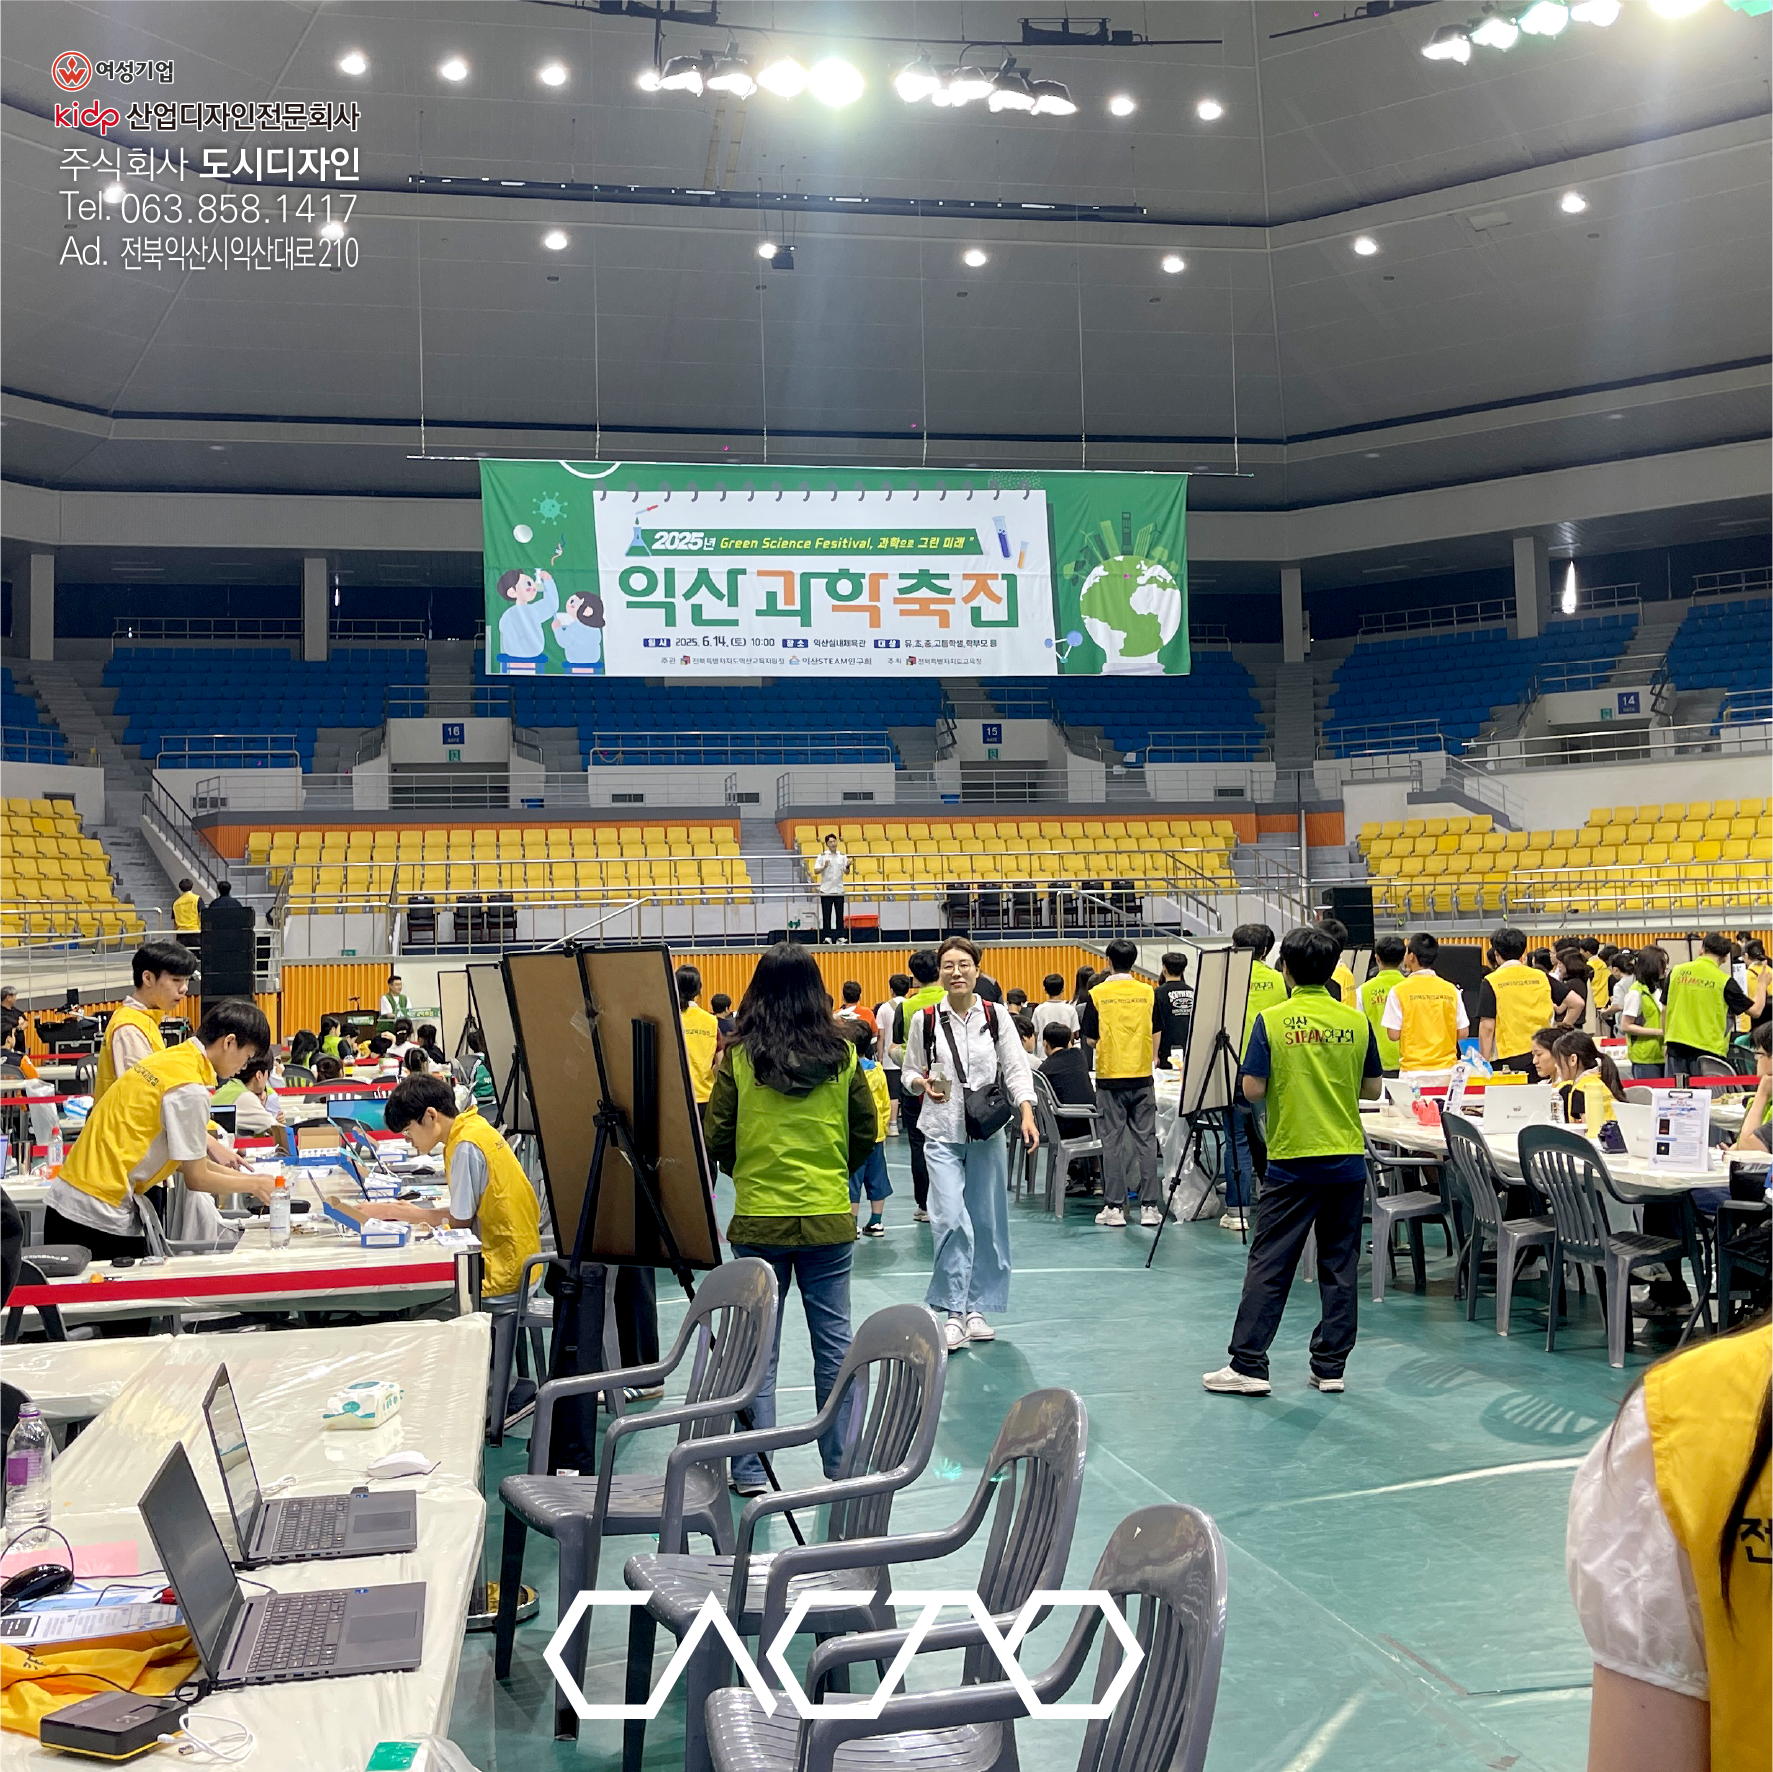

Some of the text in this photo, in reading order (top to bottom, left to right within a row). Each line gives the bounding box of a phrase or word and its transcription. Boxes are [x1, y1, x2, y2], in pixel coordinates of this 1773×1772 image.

[651, 531, 717, 551] 2025년
[720, 537, 758, 549] Green
[762, 537, 811, 549] Science
[917, 536, 940, 548] 그린
[751, 637, 775, 647] 10:00
[1622, 695, 1635, 706] 14
[447, 726, 460, 736] 16
[986, 727, 998, 736] 15
[1283, 1016, 1307, 1029] 익산
